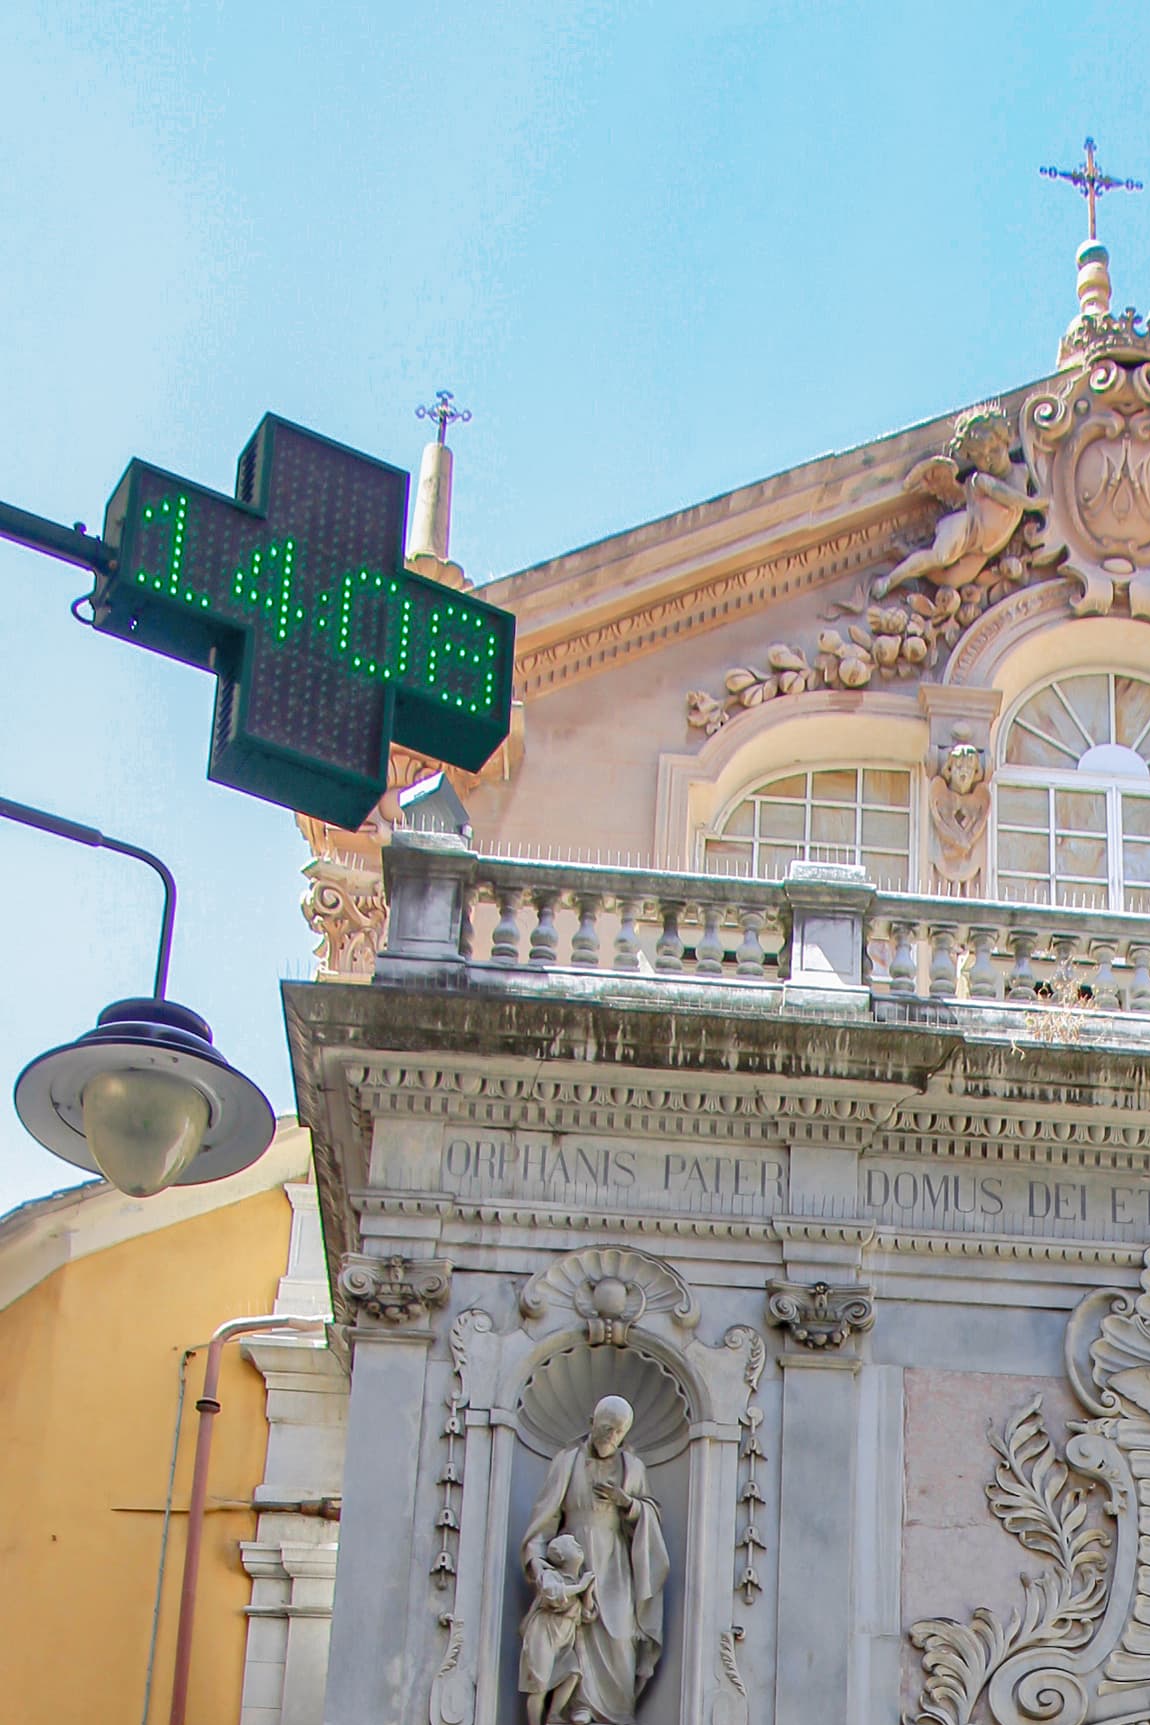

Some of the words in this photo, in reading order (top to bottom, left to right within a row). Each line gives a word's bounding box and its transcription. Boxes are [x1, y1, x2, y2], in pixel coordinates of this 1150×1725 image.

[136, 495, 497, 712] 14:08
[446, 1139, 637, 1189] ORPHANIS
[663, 1154, 785, 1198] PATER
[866, 1169, 1004, 1215] DOMUS
[1028, 1180, 1088, 1221] DEI
